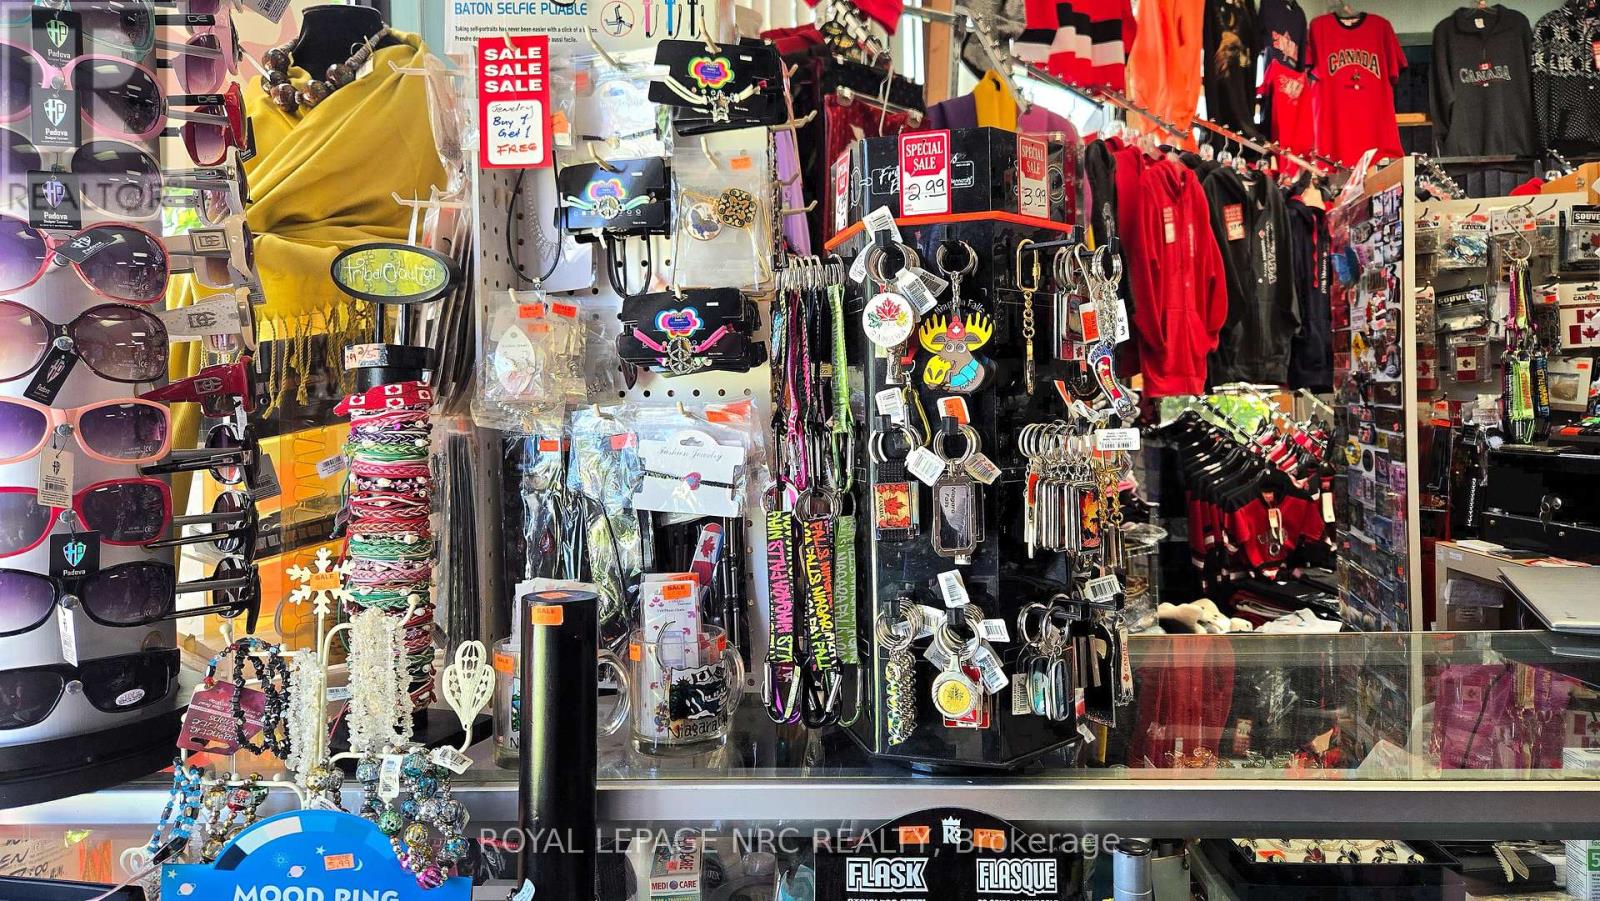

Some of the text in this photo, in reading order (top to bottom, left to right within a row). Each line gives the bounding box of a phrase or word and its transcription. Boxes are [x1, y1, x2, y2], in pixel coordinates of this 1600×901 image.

[454, 2, 588, 16] BATON SELFIE PLIABLE
[484, 47, 542, 61] SALE
[484, 63, 543, 77] SALE
[1328, 48, 1381, 80] CANADA
[484, 79, 543, 93] SALE
[493, 117, 514, 128] Buy
[498, 129, 521, 138] Get
[906, 141, 944, 157] SPECIAL
[1022, 145, 1045, 161] SPECIAL
[913, 157, 936, 171] SALE
[1027, 161, 1041, 174] SALE
[907, 178, 946, 201] 2.99
[44, 211, 68, 220] Padova
[810, 520, 830, 560] FALLS
[767, 540, 788, 580] FALLS
[63, 569, 86, 577] Padova
[667, 583, 686, 591] SALE
[772, 580, 793, 633] NIAGARA
[667, 718, 718, 739] Niagara
[651, 879, 697, 890] MEDI CARE
[848, 860, 1056, 895] FLASK FLASQUE
[233, 884, 324, 901] MOOD
